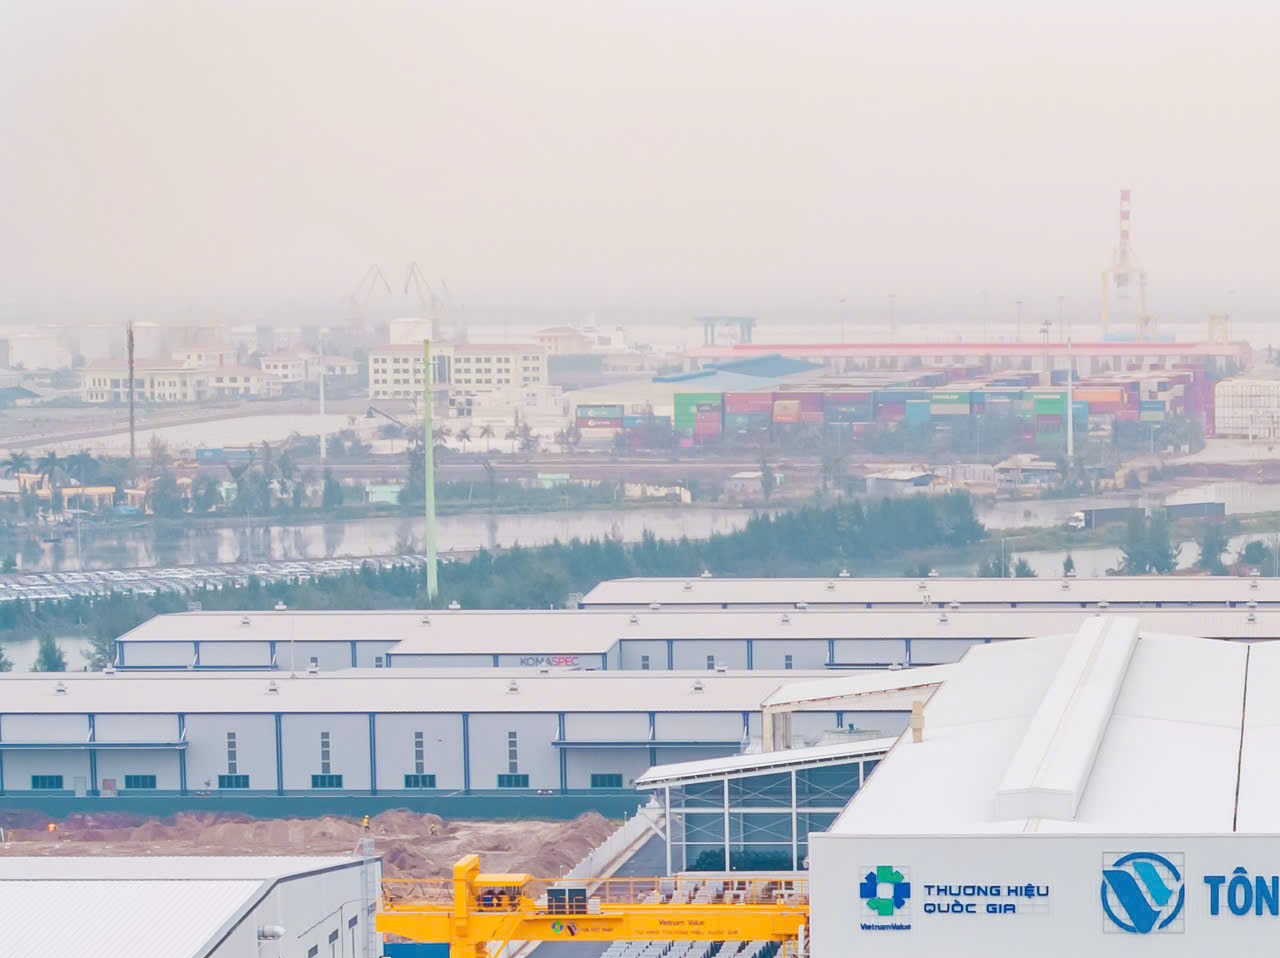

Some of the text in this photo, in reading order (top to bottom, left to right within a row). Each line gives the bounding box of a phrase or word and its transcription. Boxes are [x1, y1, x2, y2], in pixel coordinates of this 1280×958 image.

[520, 656, 580, 666] KOMASPEC
[1203, 866, 1280, 916] TÔN
[986, 903, 1016, 914] GIA
